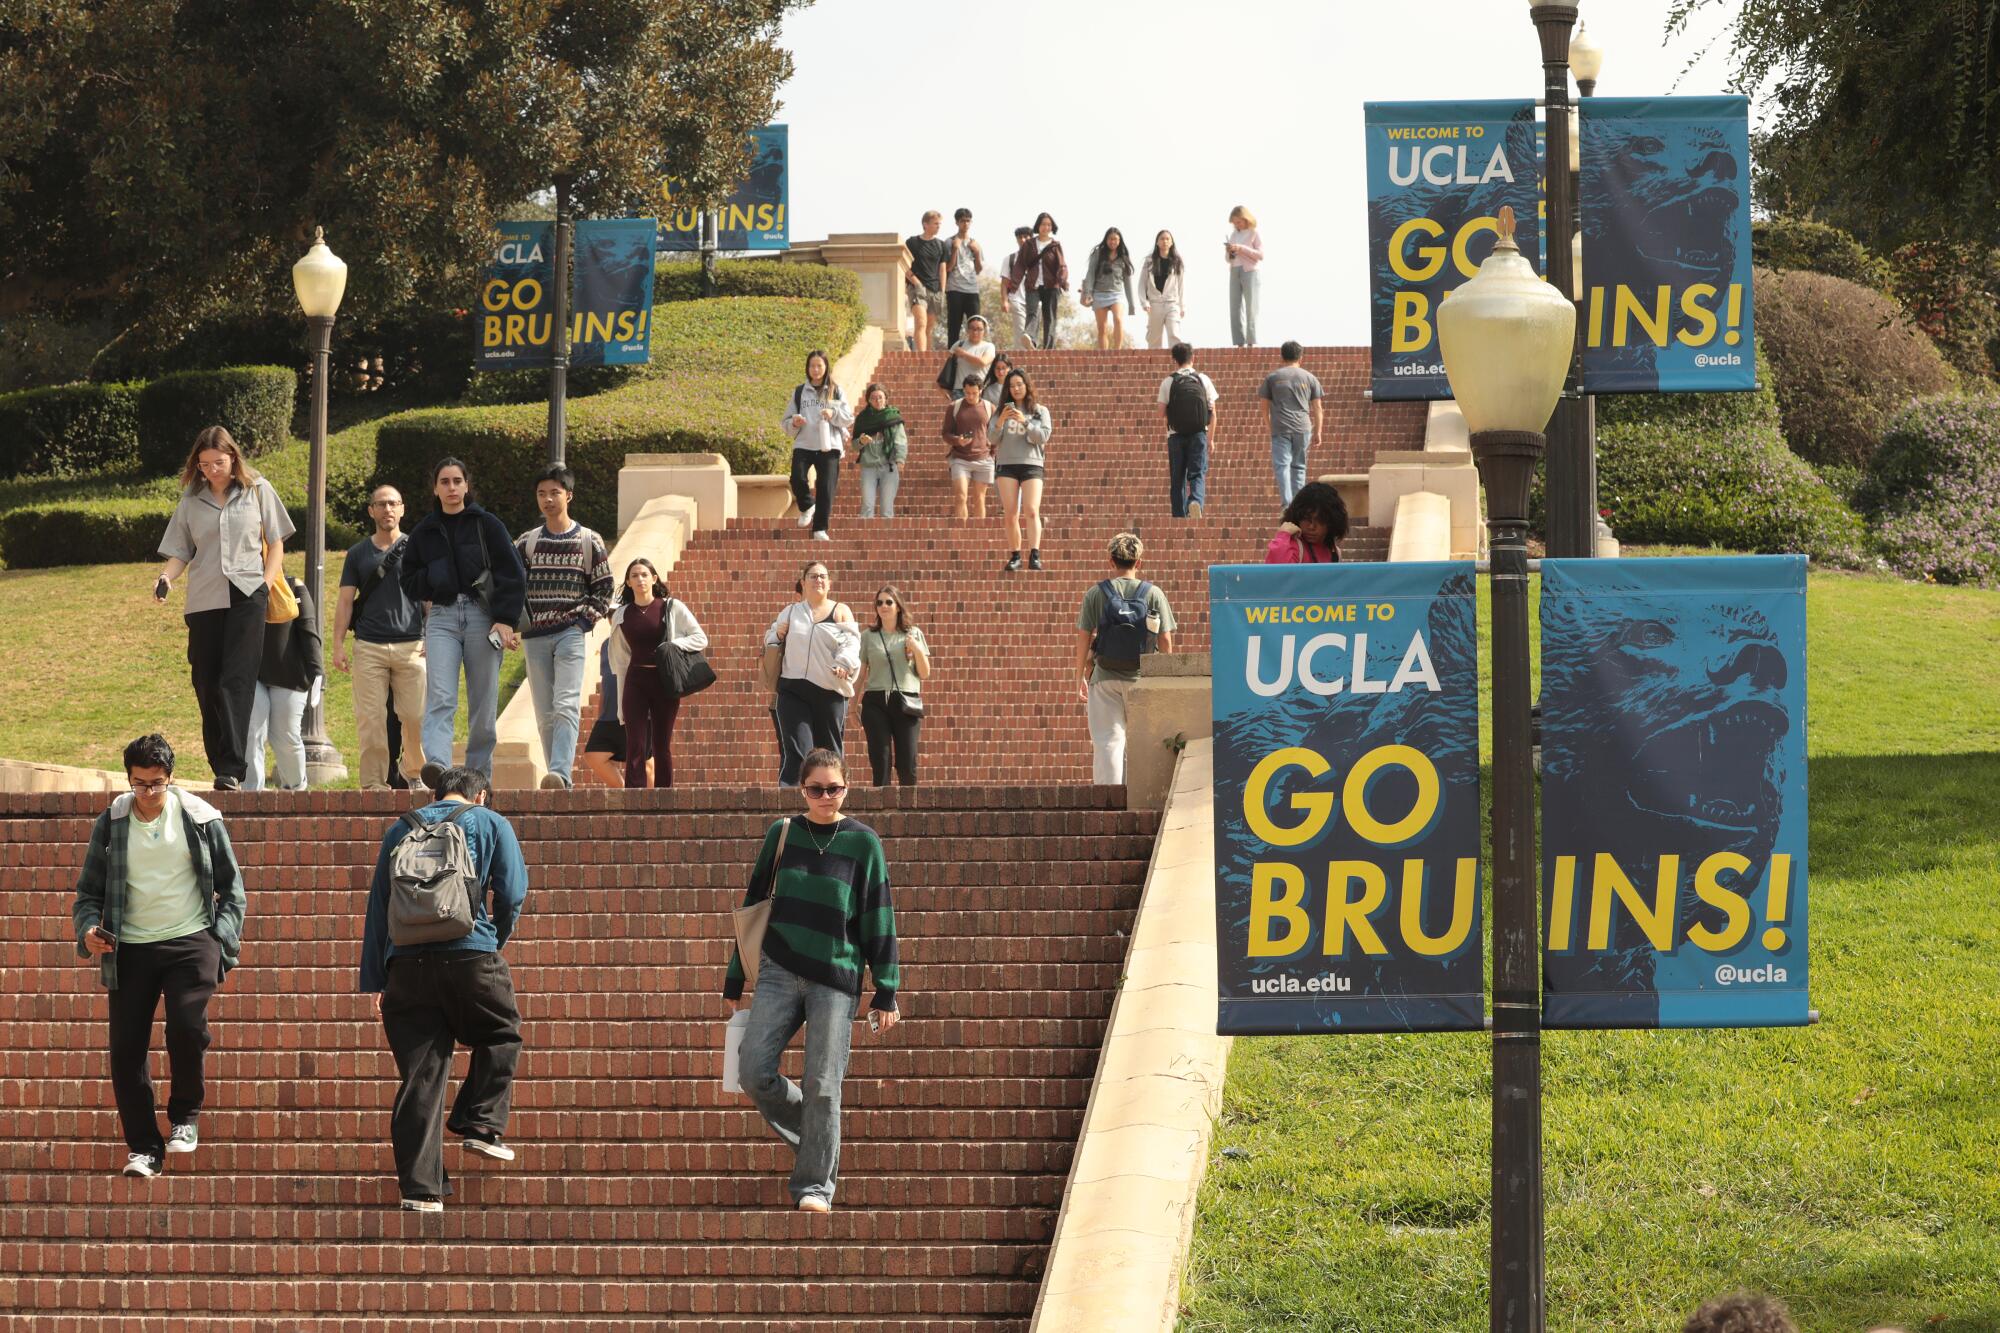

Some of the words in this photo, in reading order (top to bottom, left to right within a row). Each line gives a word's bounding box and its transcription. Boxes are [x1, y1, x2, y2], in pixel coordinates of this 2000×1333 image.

[1388, 127, 1459, 139] WELCOME
[1465, 126, 1485, 138] TO
[1387, 143, 1515, 186] UCLA
[717, 203, 785, 232] INS!
[482, 278, 543, 312] GO
[483, 313, 553, 347] BRU
[572, 310, 647, 344] INS!
[1586, 282, 1743, 348] INS!
[484, 349, 515, 359] ucla.edu
[621, 343, 644, 353] @ucla
[1694, 352, 1742, 368] @ucla
[1245, 604, 1357, 624] WELCOME
[1366, 603, 1395, 622] TO
[1244, 629, 1442, 698] UCLA
[1242, 744, 1440, 847] GO
[1246, 858, 1477, 958] BRU
[1548, 852, 1792, 953] INS!
[1251, 972, 1351, 994] ucla.edu
[1714, 963, 1788, 985] @ucla
